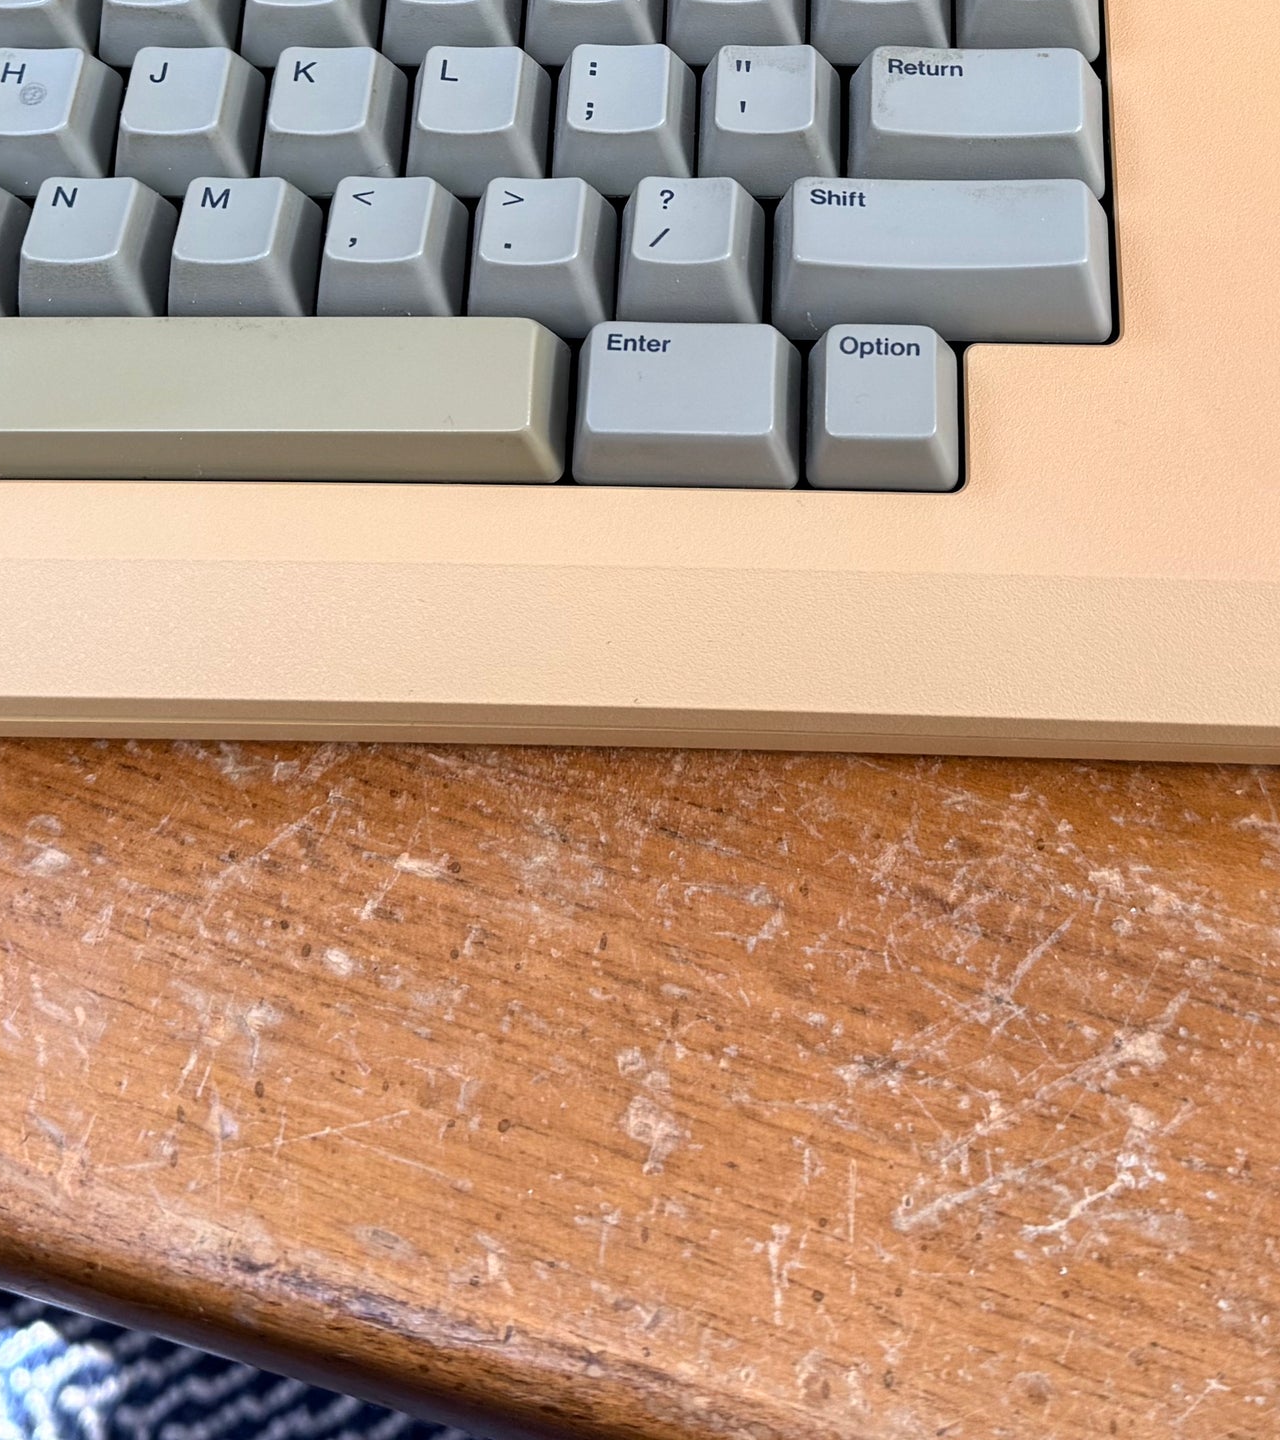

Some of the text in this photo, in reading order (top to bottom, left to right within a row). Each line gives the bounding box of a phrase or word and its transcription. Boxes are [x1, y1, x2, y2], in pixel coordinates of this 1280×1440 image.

[0, 61, 27, 85] H
[148, 61, 169, 84] J
[292, 60, 318, 84] K
[439, 58, 459, 83] L
[588, 61, 598, 77] :
[735, 59, 752, 73] "
[887, 57, 964, 77] Return
[584, 101, 595, 122] ;
[51, 185, 79, 209] N
[200, 186, 231, 210] M
[351, 190, 376, 207] <
[501, 190, 525, 207] >
[659, 187, 676, 210] ?
[809, 188, 868, 208] Shift
[347, 236, 358, 249] ,
[503, 242, 512, 250] .
[648, 227, 671, 248] /
[606, 332, 672, 353] Enter
[838, 335, 922, 360] Option
